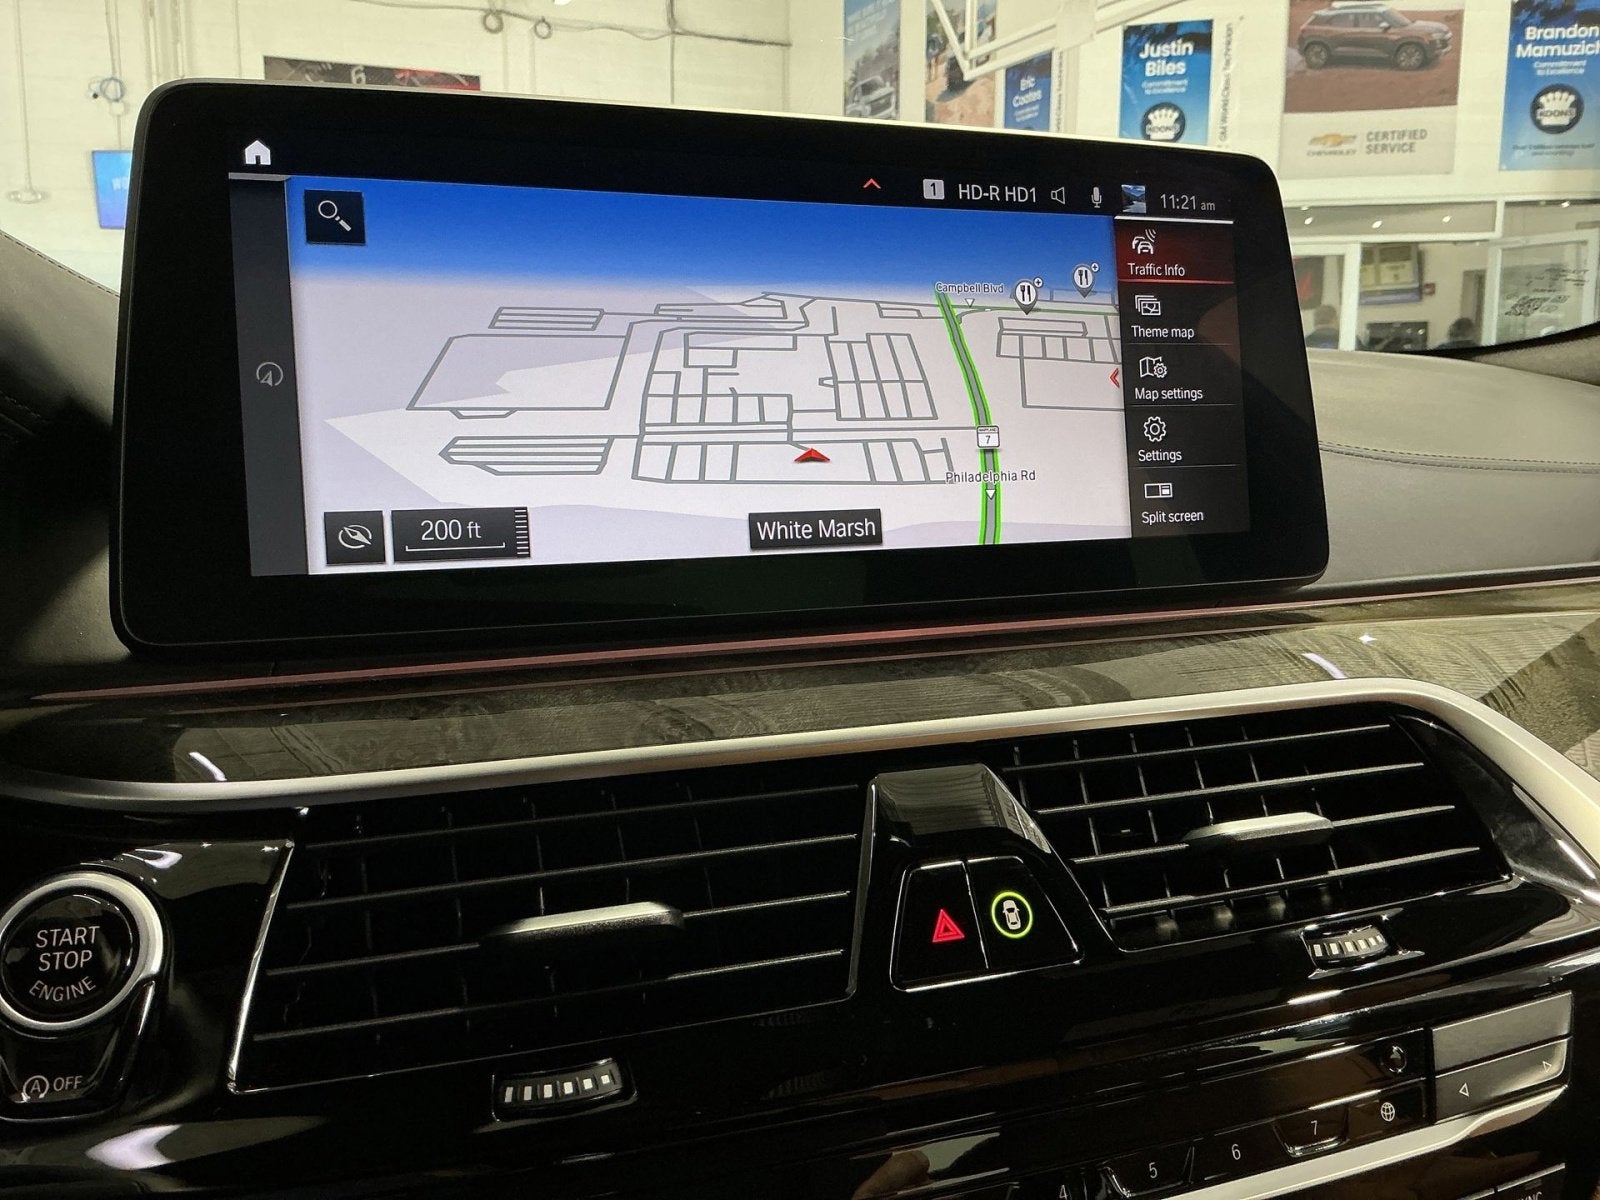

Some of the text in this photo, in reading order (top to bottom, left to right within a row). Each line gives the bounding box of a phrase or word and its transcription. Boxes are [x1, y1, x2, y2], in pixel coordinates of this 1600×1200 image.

[1525, 23, 1599, 41] Brandon
[1139, 38, 1194, 59] Justin
[1145, 58, 1186, 77] Biles
[1366, 129, 1428, 142] CERTIFIED
[1366, 142, 1416, 155] SERVICE
[958, 184, 1037, 202] HD-R HD1
[1160, 194, 1216, 211] 11:21 am
[1128, 262, 1185, 276] Traffic Info
[935, 282, 1004, 294] Campbell Blvd
[1131, 325, 1195, 340] Theme map
[1134, 387, 1203, 402] Map settings
[985, 435, 991, 444] 7
[1138, 449, 1182, 463] Settings
[945, 470, 1036, 484] Philadelphia Rd
[1141, 511, 1204, 525] Split screen
[420, 519, 482, 541] 200 ft
[756, 518, 876, 541] White Marsh
[36, 926, 100, 949] START
[38, 950, 93, 972] STOP
[28, 976, 97, 1003] ENGINE
[53, 1076, 83, 1091] OFF
[1310, 1120, 1319, 1136] 7
[1231, 1144, 1242, 1161] 6
[1148, 1162, 1158, 1179] 5
[1058, 1184, 1069, 1200] 4
